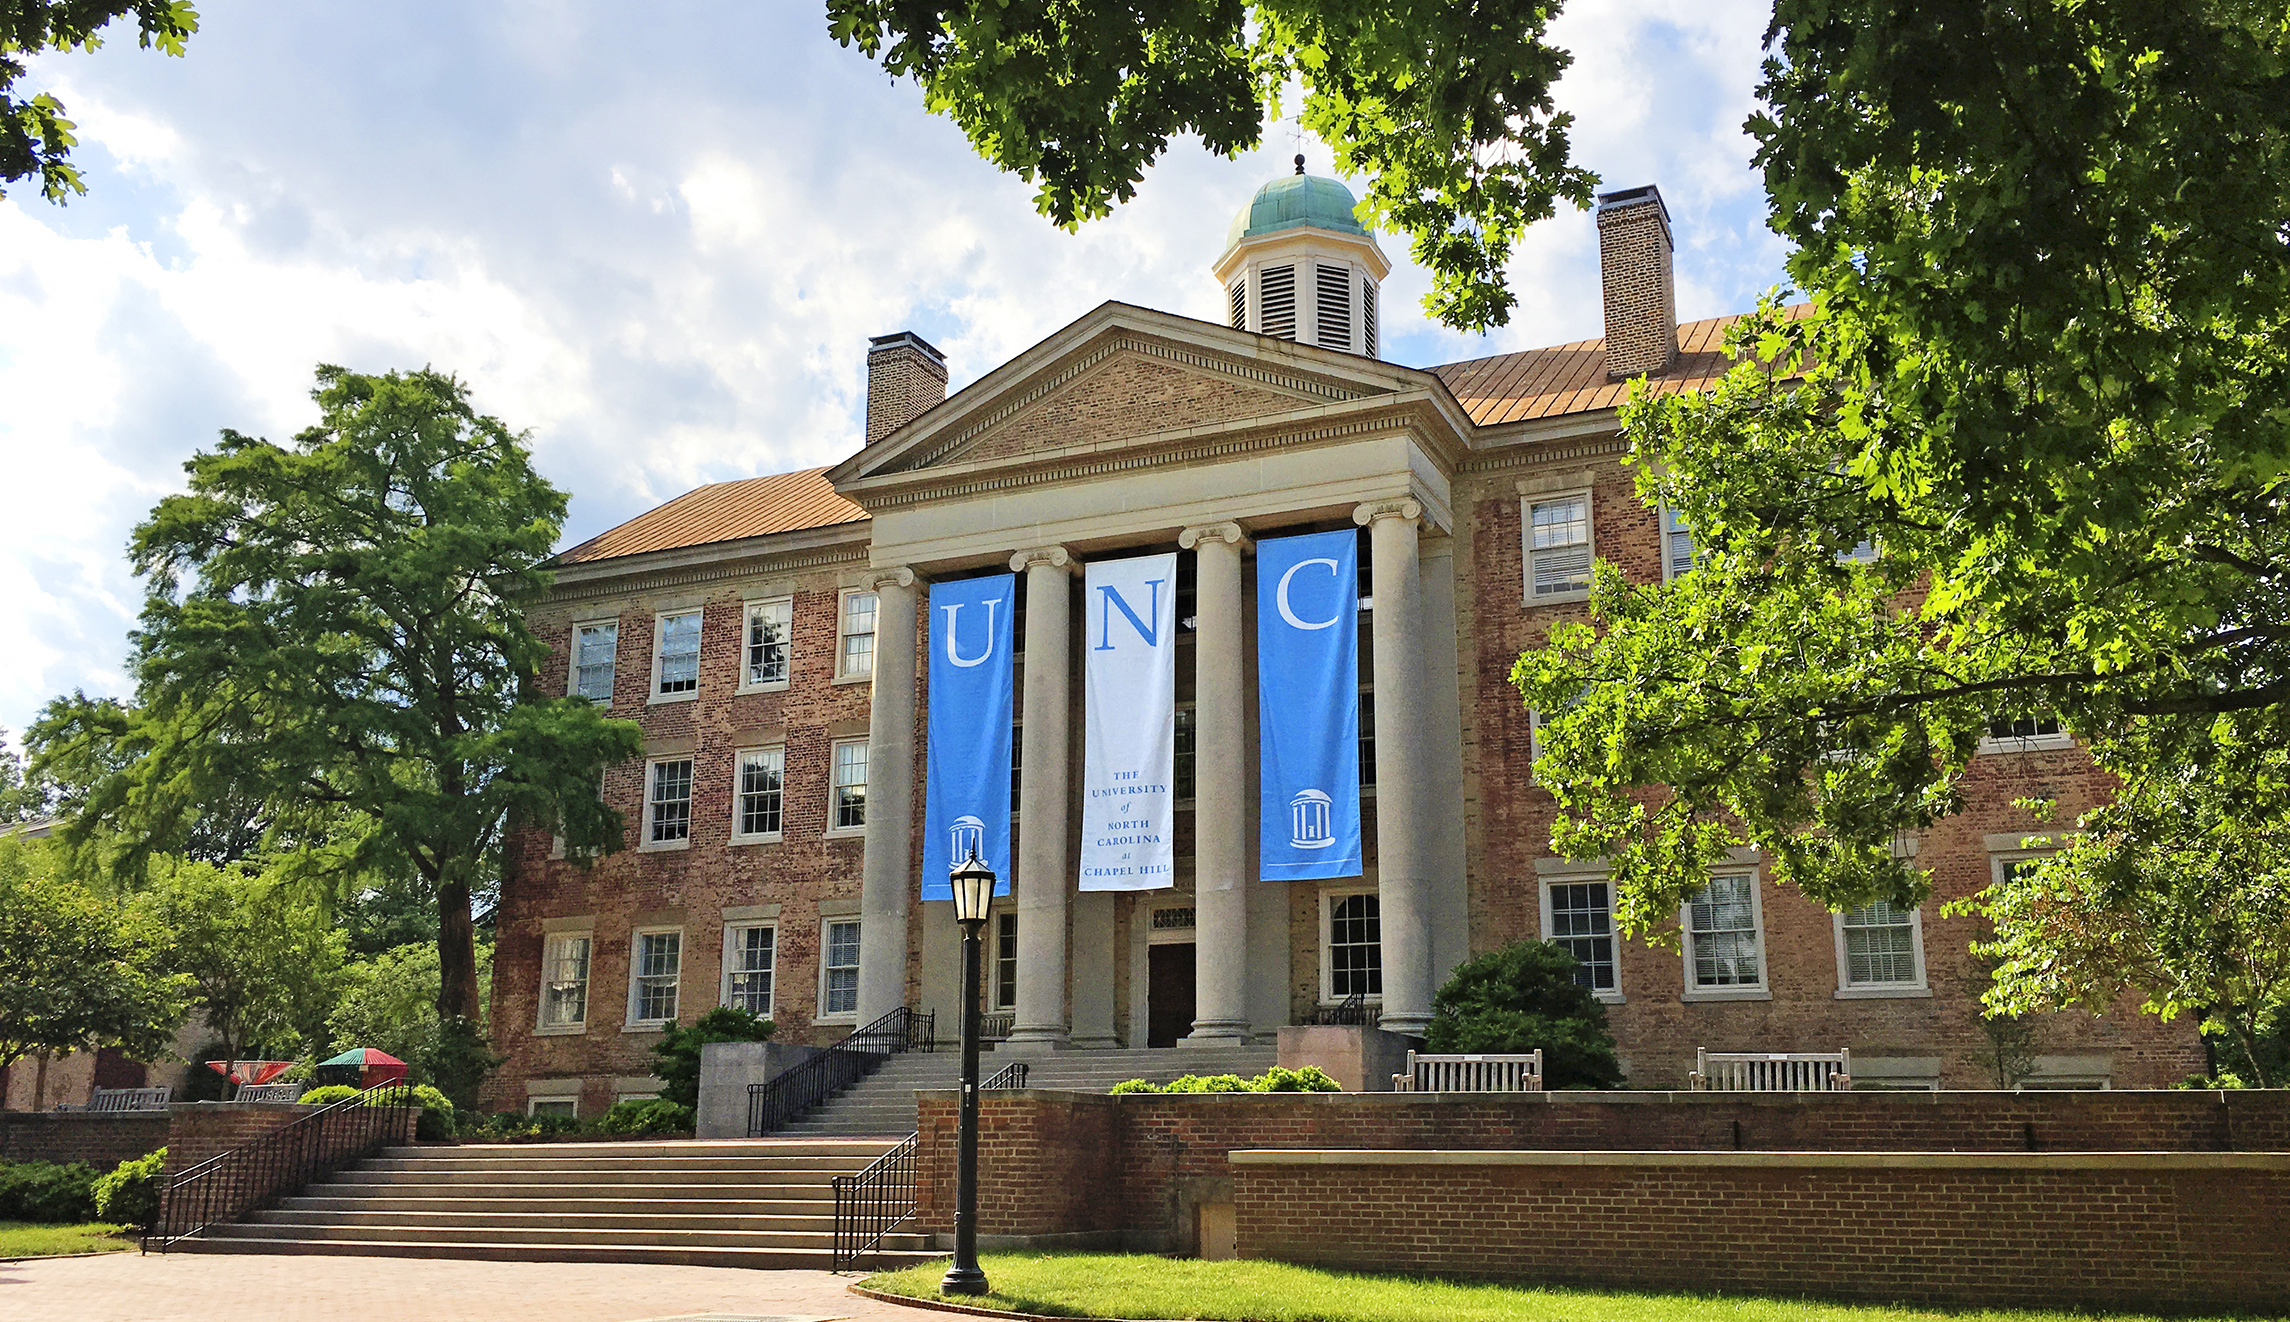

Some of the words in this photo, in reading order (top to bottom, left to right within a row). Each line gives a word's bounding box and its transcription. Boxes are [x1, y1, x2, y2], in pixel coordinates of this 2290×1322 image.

[1276, 558, 1339, 630] C
[1094, 579, 1165, 651] N
[940, 598, 1002, 667] U
[1113, 770, 1139, 780] THE
[1091, 784, 1167, 798] UNIVERSITY
[1120, 801, 1131, 814] of
[1107, 820, 1149, 831] NORTH
[1097, 834, 1160, 847] CAROLINA
[1121, 852, 1131, 860] at
[1084, 866, 1134, 877] CHAPEL
[1139, 864, 1169, 875] HILL
